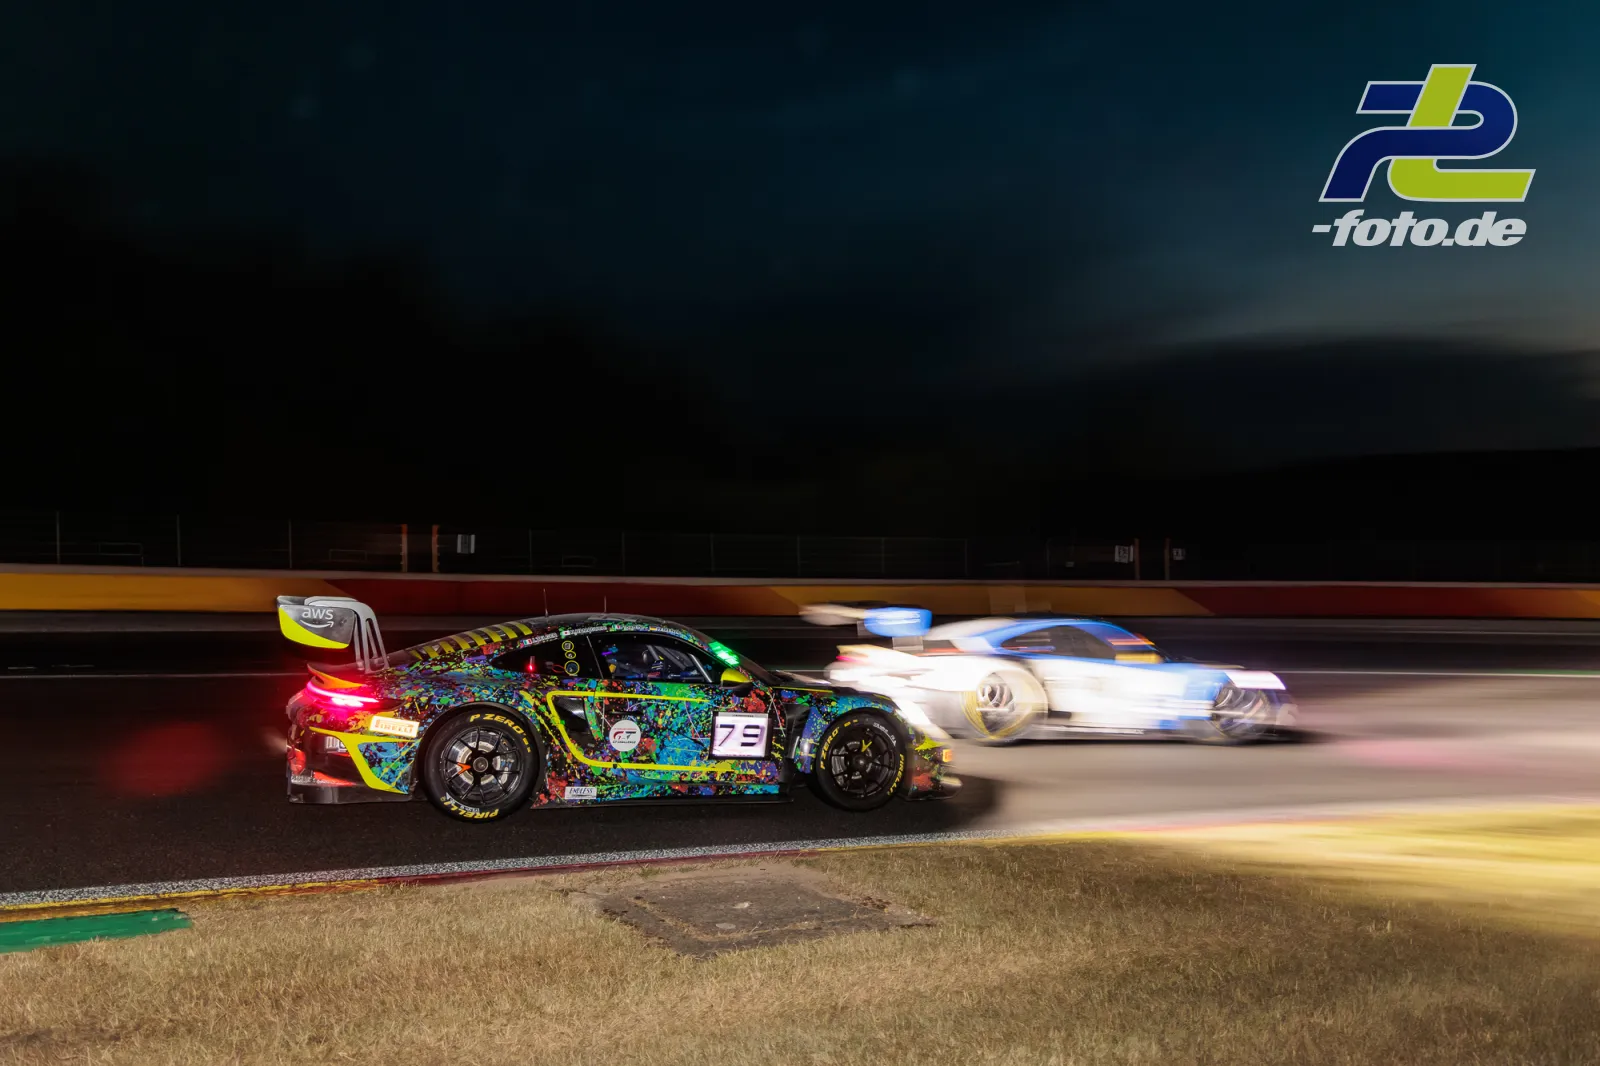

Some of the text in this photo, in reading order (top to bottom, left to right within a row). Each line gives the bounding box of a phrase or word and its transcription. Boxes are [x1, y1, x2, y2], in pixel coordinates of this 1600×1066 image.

[301, 607, 334, 620] aws
[469, 713, 525, 734] P ZERO
[718, 723, 765, 747] 79
[443, 801, 499, 819] PIRELLI
